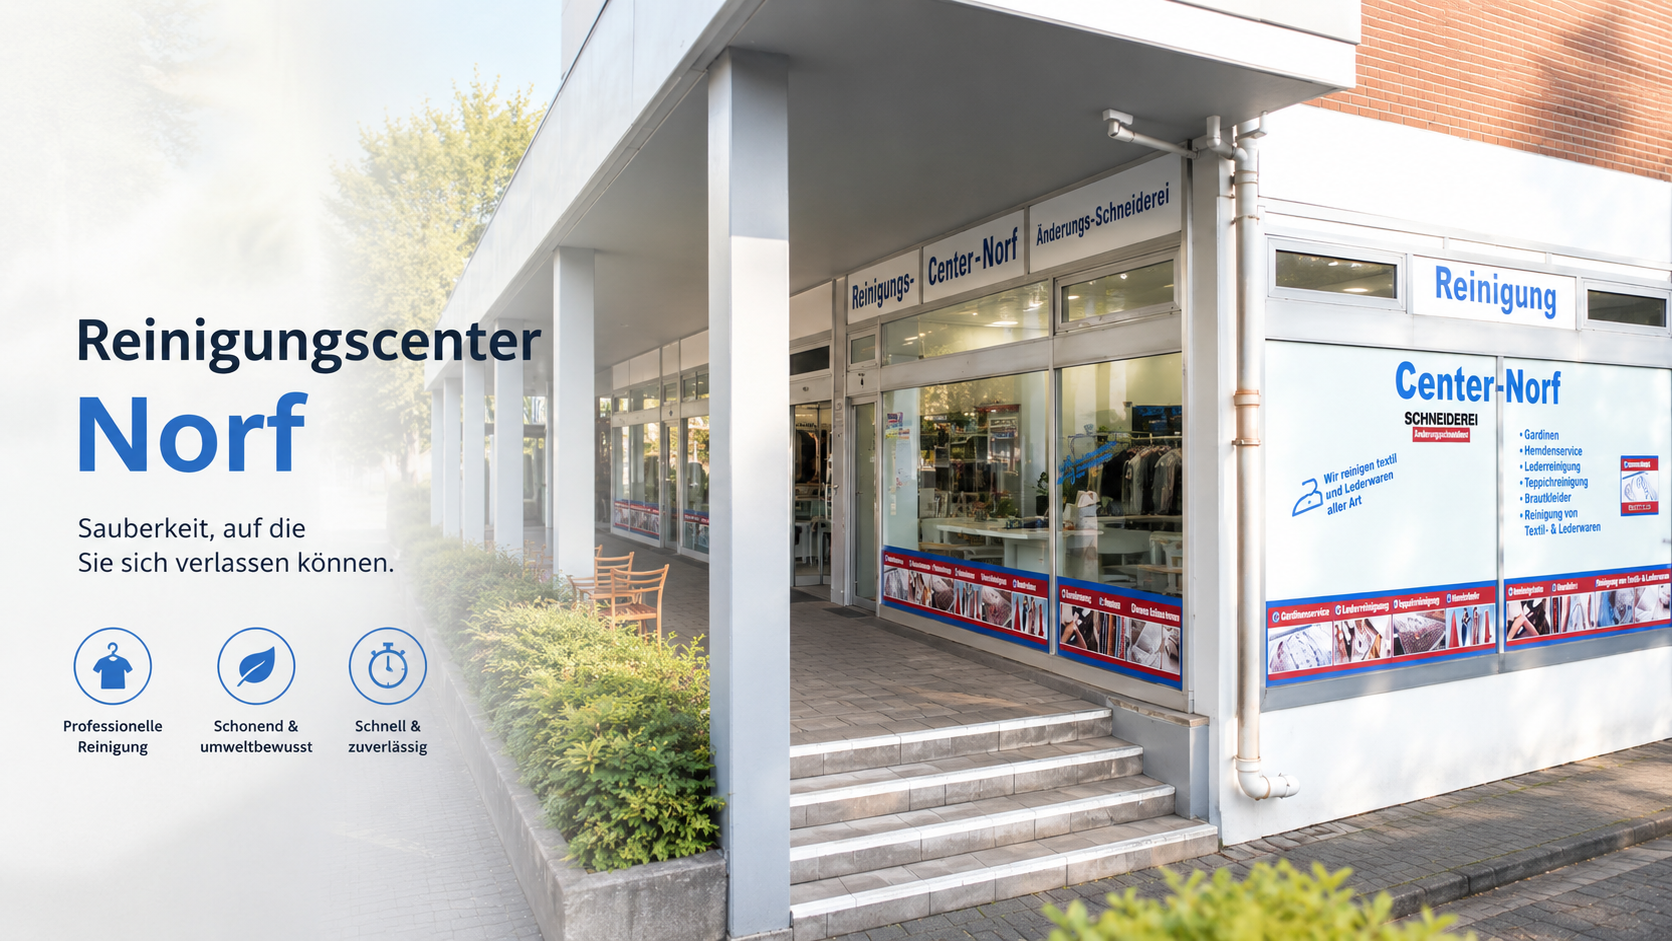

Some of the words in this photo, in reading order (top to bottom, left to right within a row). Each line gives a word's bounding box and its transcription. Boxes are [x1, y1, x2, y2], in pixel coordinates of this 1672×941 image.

[1036, 182, 1169, 246] Änderungs-Schneiderei
[852, 273, 915, 310] Reinigungs-
[1435, 265, 1557, 320] Reinigung
[1395, 361, 1562, 405] Center-Norf
[1404, 411, 1478, 426] SCHNEIDEREI
[1524, 428, 1560, 441] Gardinen
[1524, 445, 1583, 457] Hemdenservice
[1323, 472, 1339, 484] Wir
[1341, 463, 1375, 480] reinigen
[1376, 453, 1398, 468] textil
[1524, 461, 1581, 474] Lederreinigung
[1325, 484, 1343, 500] und
[1344, 470, 1394, 494] Lederwaren
[1524, 476, 1589, 490] Teppichreinigung
[1327, 501, 1347, 515] aller
[1349, 494, 1363, 509] Art
[1524, 492, 1572, 504] Brautkleider
[1524, 508, 1563, 522] Reinigung
[1564, 509, 1579, 519] von
[1524, 523, 1549, 537] Textil-
[1550, 523, 1558, 535] &
[1558, 522, 1602, 535] Lederwaren
